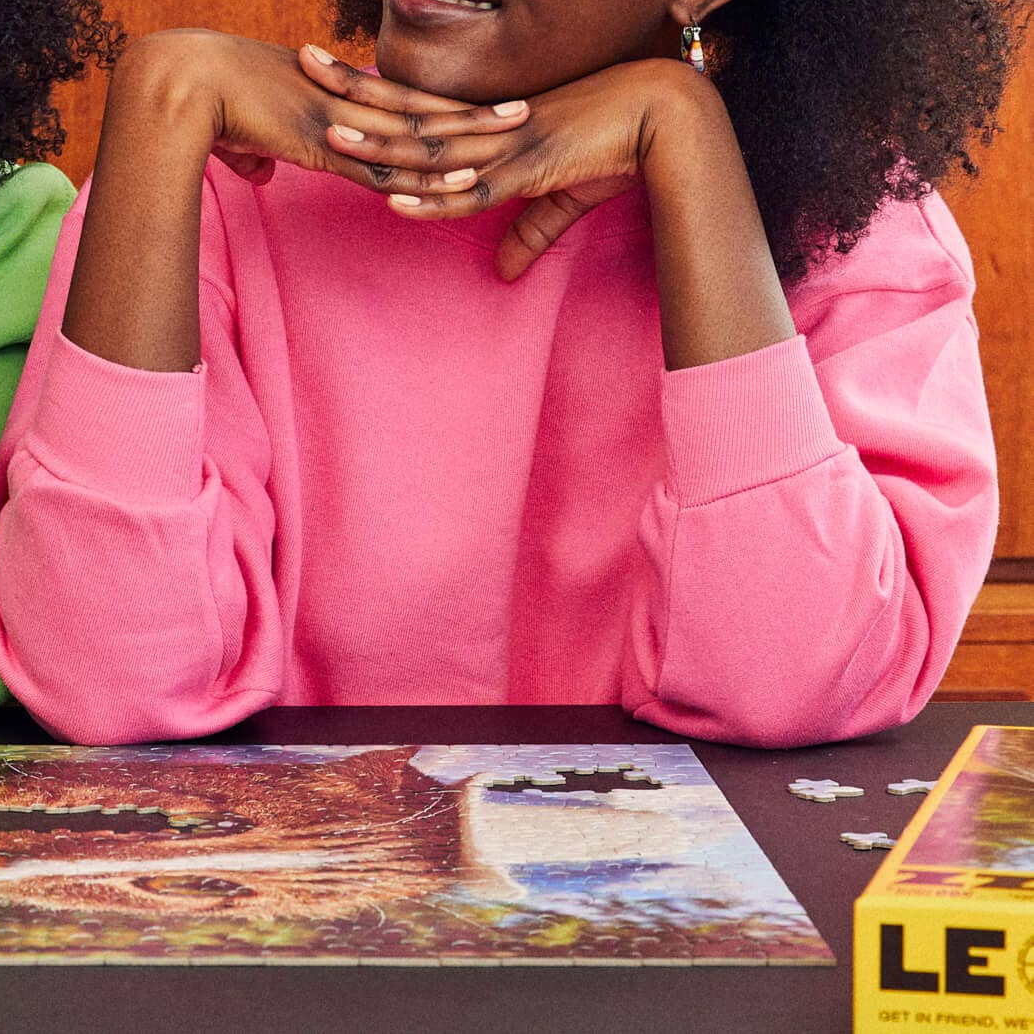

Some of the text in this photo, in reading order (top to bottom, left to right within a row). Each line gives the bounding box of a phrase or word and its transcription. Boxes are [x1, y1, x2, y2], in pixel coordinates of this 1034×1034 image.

[878, 1009, 911, 1023] GET
[915, 1012, 932, 1024] IN
[936, 1013, 999, 1030] FRIEND,
